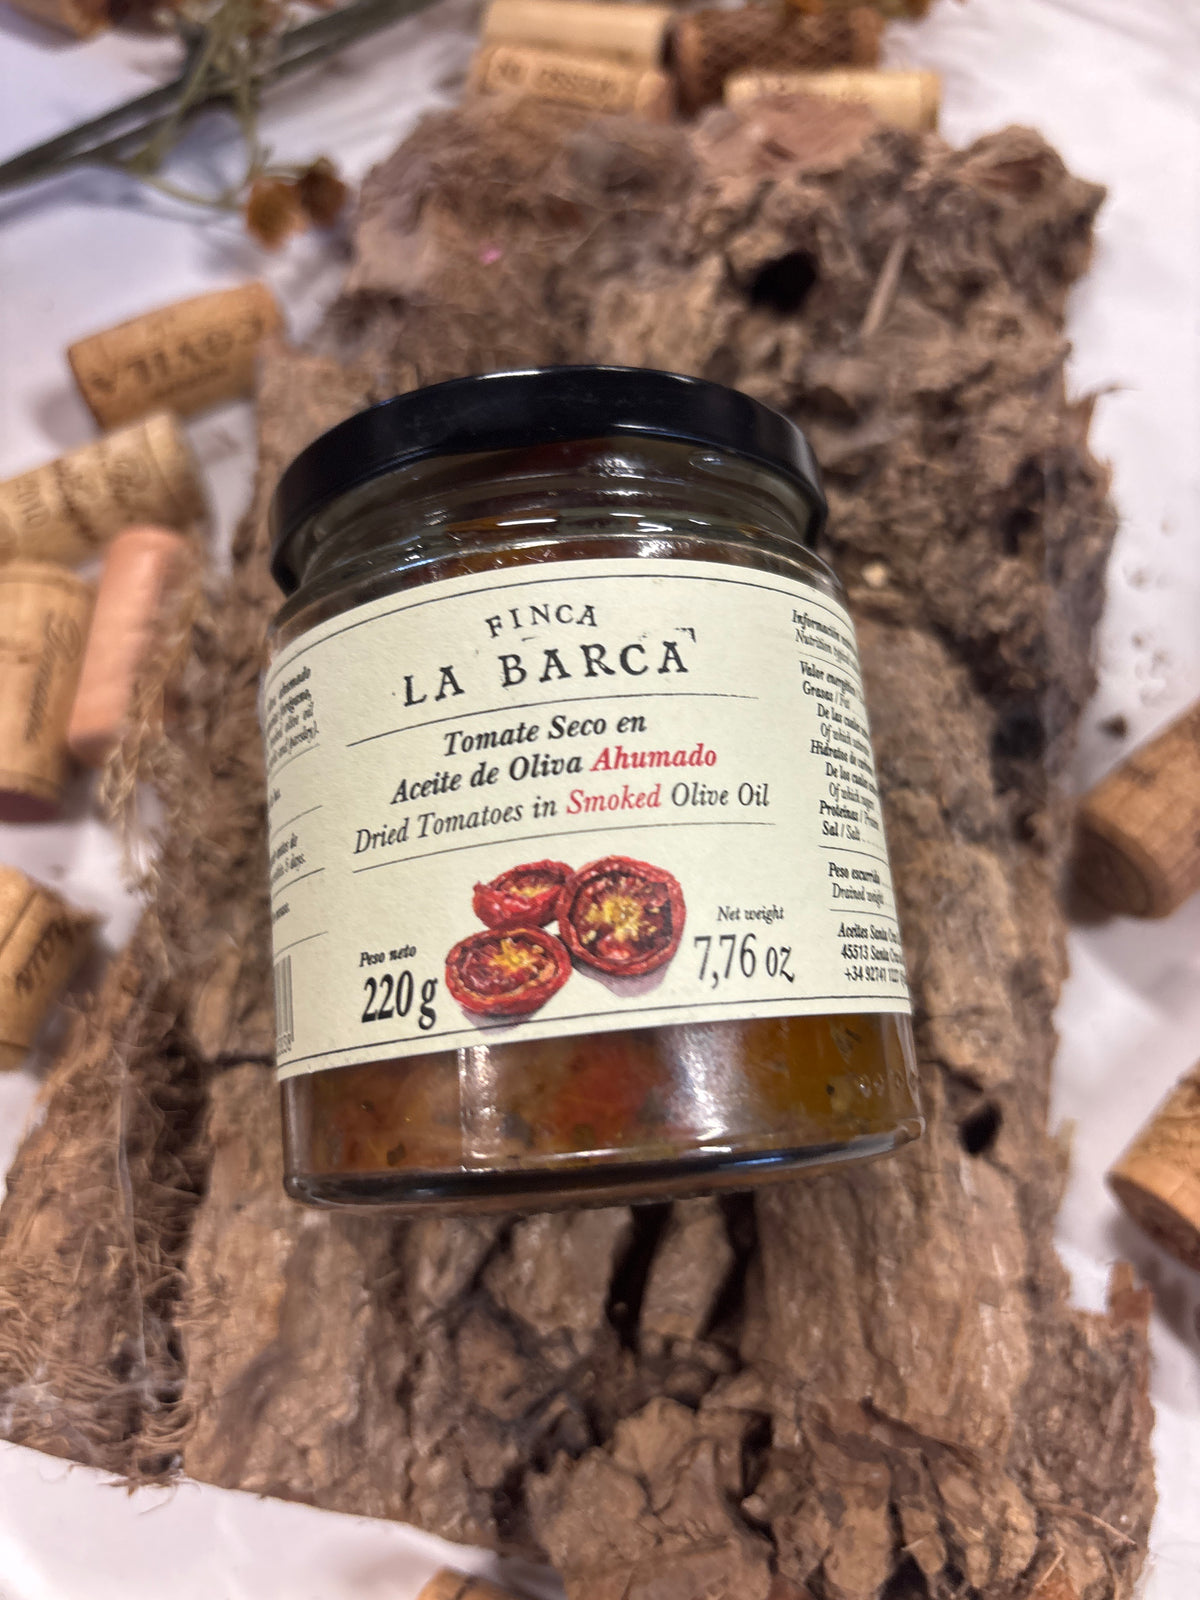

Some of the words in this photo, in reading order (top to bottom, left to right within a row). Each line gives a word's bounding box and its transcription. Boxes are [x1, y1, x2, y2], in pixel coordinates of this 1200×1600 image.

[484, 602, 598, 639] FINCA
[402, 664, 465, 707] LA
[497, 640, 689, 688] BARCA
[443, 727, 541, 758] Tomate
[547, 714, 607, 741] Seco
[616, 715, 648, 734] en
[389, 772, 463, 806] Aceite
[469, 763, 500, 788] de
[508, 753, 584, 782] Oliva
[588, 742, 718, 773] Ahumado
[352, 817, 409, 856] Dried
[417, 801, 525, 839] Tomatoes
[532, 794, 560, 819] in
[565, 783, 662, 816] Smoked
[670, 782, 730, 807] Olive
[737, 782, 771, 808] Oil
[821, 820, 839, 837] Sal
[828, 861, 850, 878] Peso
[716, 905, 742, 923] Net
[744, 904, 786, 925] weight
[358, 950, 386, 968] Peso
[387, 944, 418, 963] neto
[692, 932, 758, 991] 7,76
[765, 944, 797, 984] oz
[360, 969, 414, 1024] 220
[417, 975, 439, 1031] g
